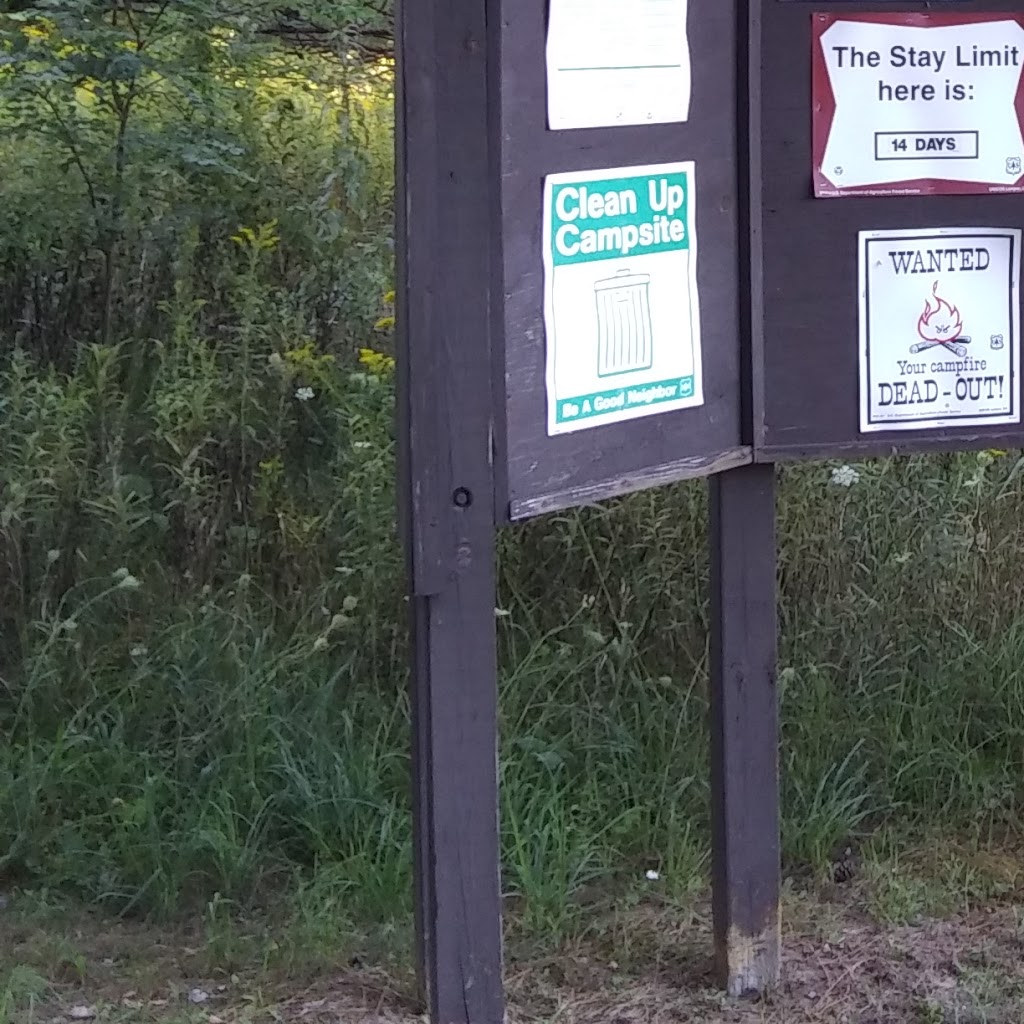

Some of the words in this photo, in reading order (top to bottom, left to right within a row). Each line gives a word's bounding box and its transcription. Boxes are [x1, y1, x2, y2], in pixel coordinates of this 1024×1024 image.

[832, 46, 881, 68] The
[890, 45, 946, 73] Stay
[956, 45, 1019, 67] Limit
[878, 80, 936, 101] here
[945, 79, 974, 100] is:
[891, 139, 908, 152] 14
[915, 137, 957, 152] DAYS
[555, 185, 638, 222] Clean
[648, 178, 684, 216] Up
[555, 214, 685, 257] Campsite
[888, 247, 990, 275] WANTED
[896, 359, 926, 376] Your
[930, 356, 987, 377] campfire
[562, 402, 579, 419] Be
[582, 400, 591, 414] A
[593, 391, 625, 412] Good
[627, 384, 678, 404] Neighbor
